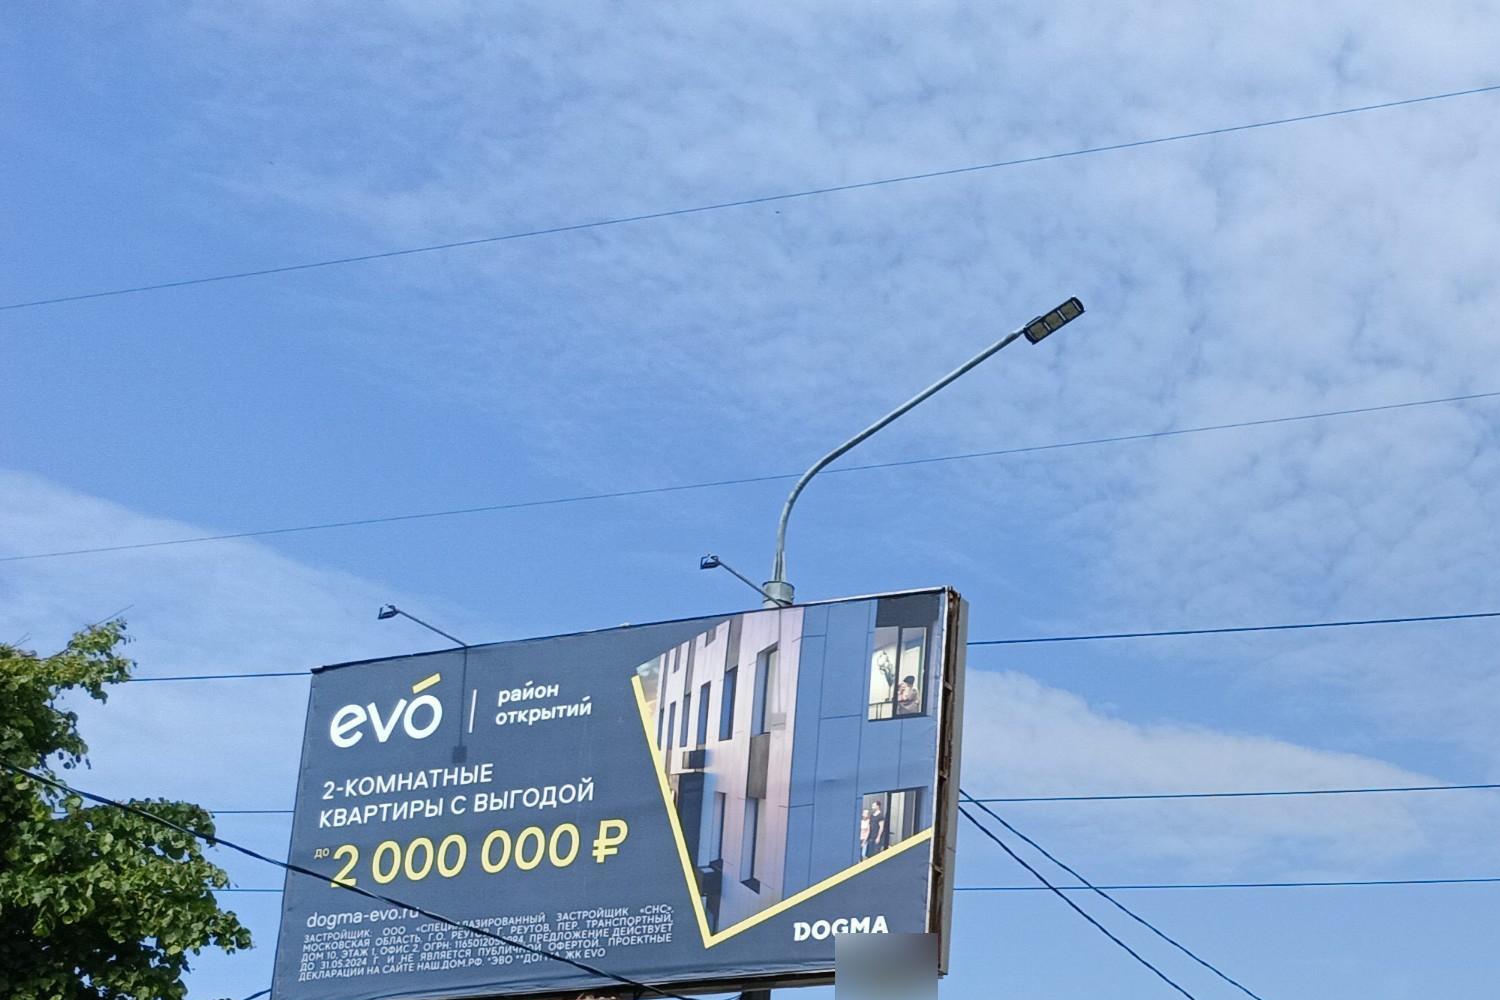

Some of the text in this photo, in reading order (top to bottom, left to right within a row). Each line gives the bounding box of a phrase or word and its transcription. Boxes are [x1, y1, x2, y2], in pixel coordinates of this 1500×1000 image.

[497, 680, 560, 707] район
[495, 696, 592, 726] открытий
[322, 763, 494, 800] 2-КОМНАТНЫЕ
[319, 777, 595, 828] КВАРТИРЫ С ВЫГОДОЙ
[330, 844, 360, 889] 2
[372, 834, 468, 885] 000
[481, 822, 580, 874] 000
[306, 907, 420, 930] dogma-evo.ru
[382, 926, 406, 936] ООО
[556, 907, 629, 921] ЗАСТРОЙЩИК
[793, 915, 889, 942] DOGMA
[300, 962, 316, 972] ДО
[387, 955, 395, 964] И
[401, 953, 414, 963] НЕ
[420, 948, 472, 961] ЯВЛЯЕТСЯ
[608, 933, 673, 946] ПРОЕКТНЫЕ
[301, 951, 324, 963] ДОМ
[341, 947, 369, 959] ЭТАЖ
[380, 944, 410, 955] ОФИС
[529, 928, 609, 943] ПРЕДЛОЖЕНИЕ
[612, 923, 673, 938] ДЕЙСТВУЕТ
[302, 939, 371, 953] МОСКОВСКАЯ
[298, 967, 365, 982] ДЕКЛАРАЦИИ
[367, 965, 380, 975] НА
[382, 963, 415, 974] САЙТЕ
[583, 948, 606, 959] EVO
